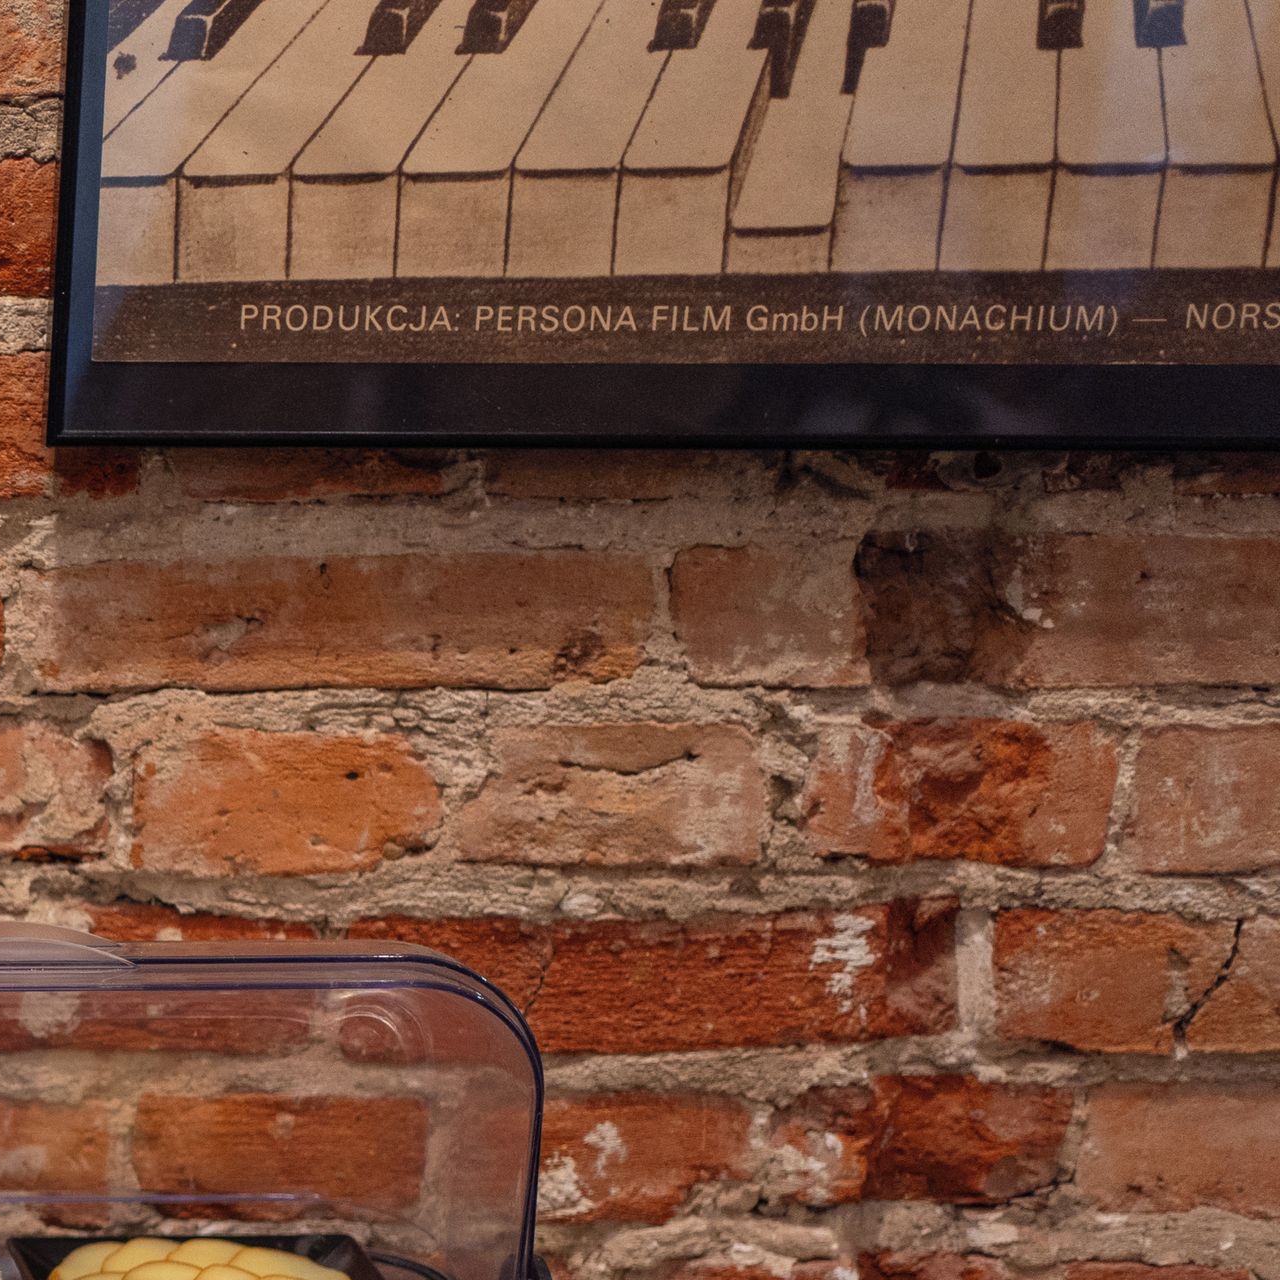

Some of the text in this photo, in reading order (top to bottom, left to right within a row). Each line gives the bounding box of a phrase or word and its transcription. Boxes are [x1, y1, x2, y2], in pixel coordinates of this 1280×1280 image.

[239, 303, 461, 332] PRODUKCJA:
[473, 303, 639, 333] PERSONA
[650, 303, 733, 332] FILM
[745, 303, 845, 332] GmbH
[858, 303, 1120, 338] (MONACHIUM)
